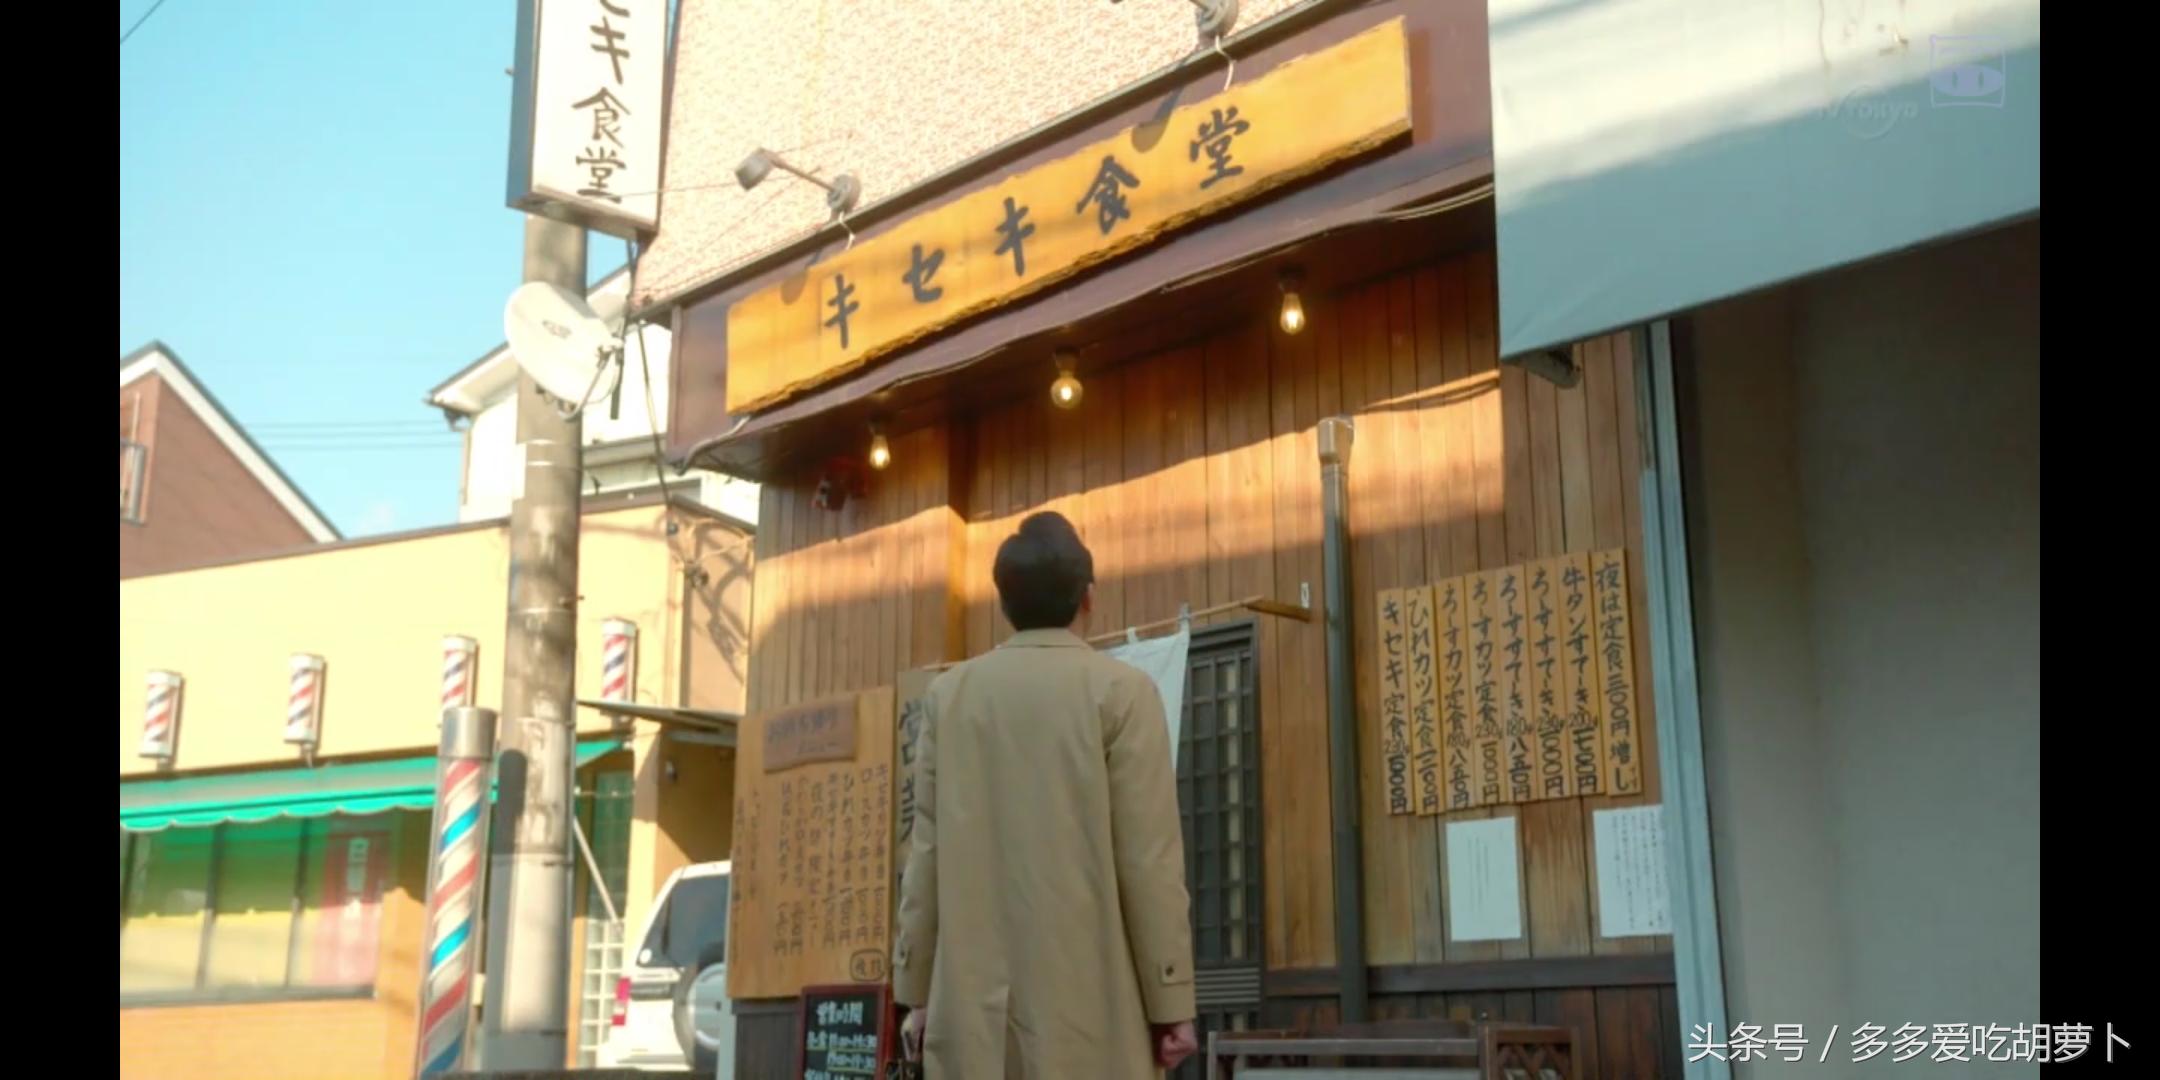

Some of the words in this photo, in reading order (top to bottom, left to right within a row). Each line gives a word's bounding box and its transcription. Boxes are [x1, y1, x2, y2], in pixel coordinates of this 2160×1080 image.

[821, 104, 1251, 350] キセキ食堂
